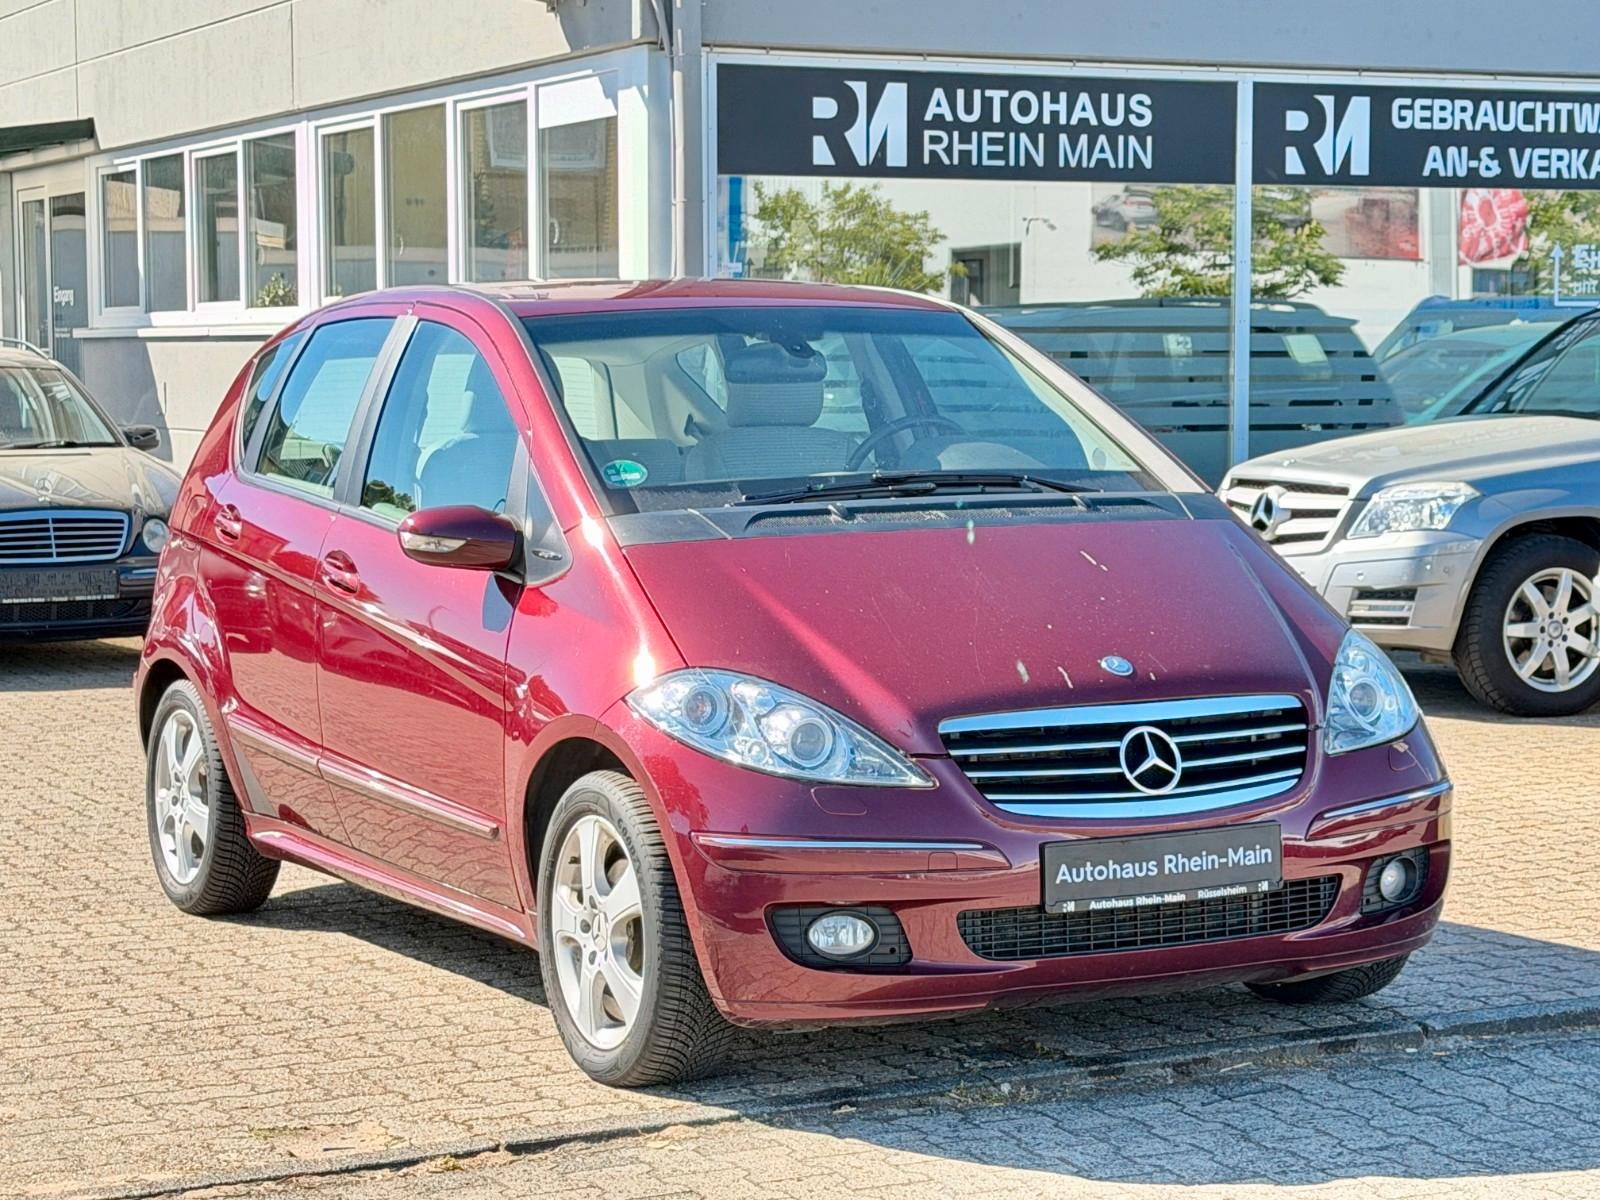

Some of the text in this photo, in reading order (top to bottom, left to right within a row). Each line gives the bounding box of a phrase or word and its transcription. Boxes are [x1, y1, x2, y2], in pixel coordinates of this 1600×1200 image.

[923, 87, 1153, 127] AUTOHAUS
[1391, 97, 1600, 134] GEBRAUCHTW
[923, 129, 1153, 169] RHEIN MAIN
[1422, 145, 1502, 178] AN-&
[1055, 844, 1273, 884] Autohaus Rhein-Main
[1089, 896, 1134, 911] Autohaus
[1136, 891, 1186, 906] Rhein-Main
[1198, 883, 1247, 899] Rüsselsheim
